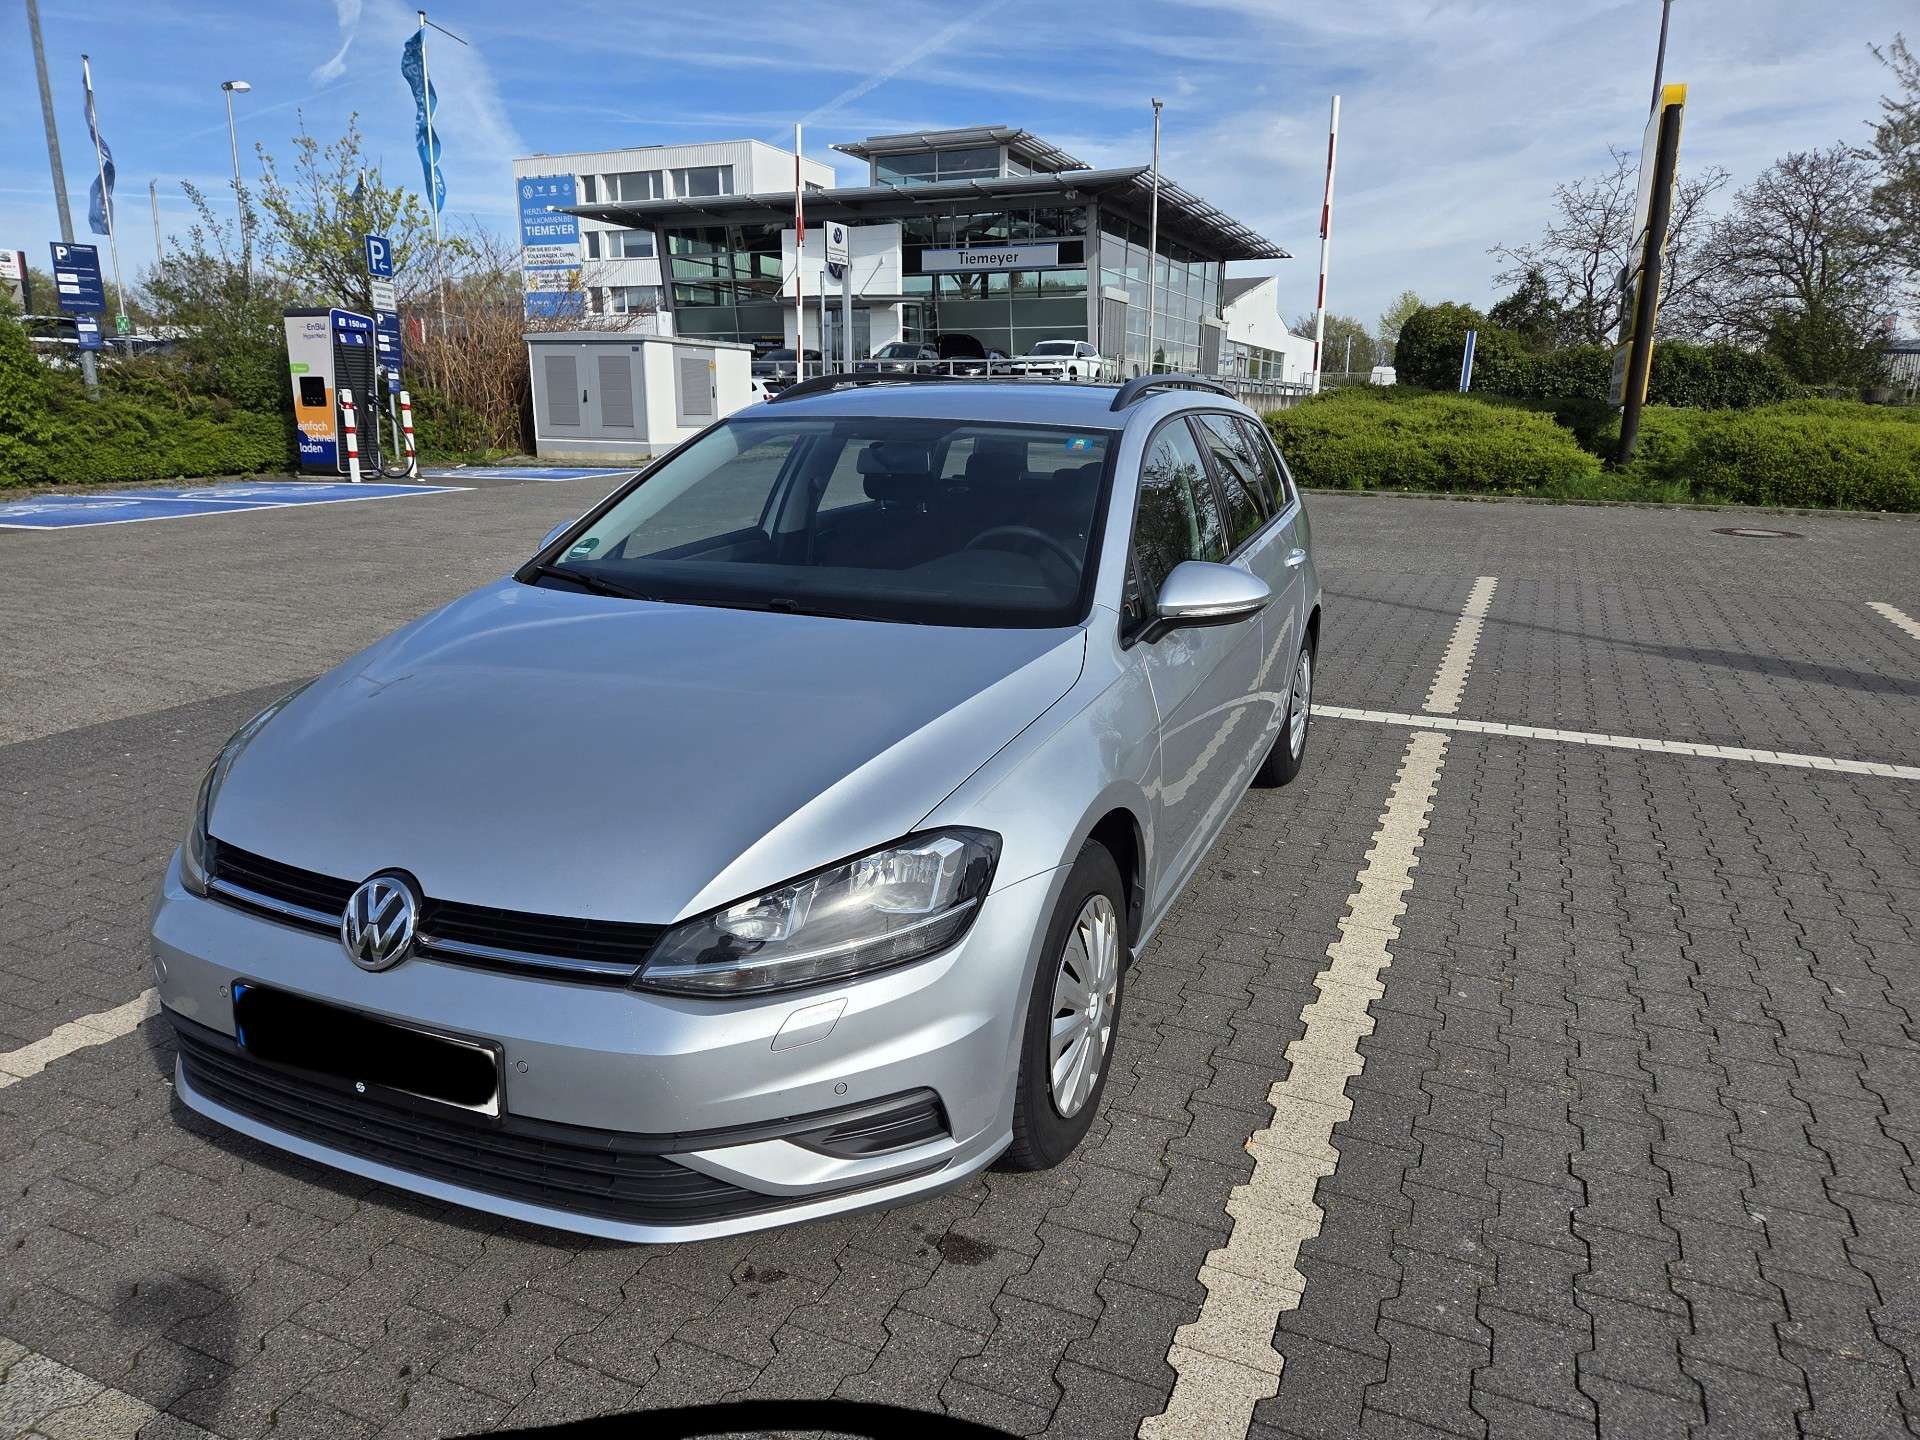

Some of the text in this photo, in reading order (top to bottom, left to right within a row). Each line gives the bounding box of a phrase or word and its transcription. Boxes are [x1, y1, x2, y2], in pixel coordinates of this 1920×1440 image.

[526, 225, 575, 236] TIEMEYER
[55, 245, 68, 260] P
[369, 239, 385, 270] P
[958, 251, 1019, 267] Tiemeyer
[348, 318, 359, 328] 150
[376, 312, 384, 325] P
[306, 322, 326, 331] EnBW
[297, 420, 328, 432] einfach
[307, 431, 336, 443] schnell
[299, 442, 324, 453] laden
[341, 877, 416, 970] VW
